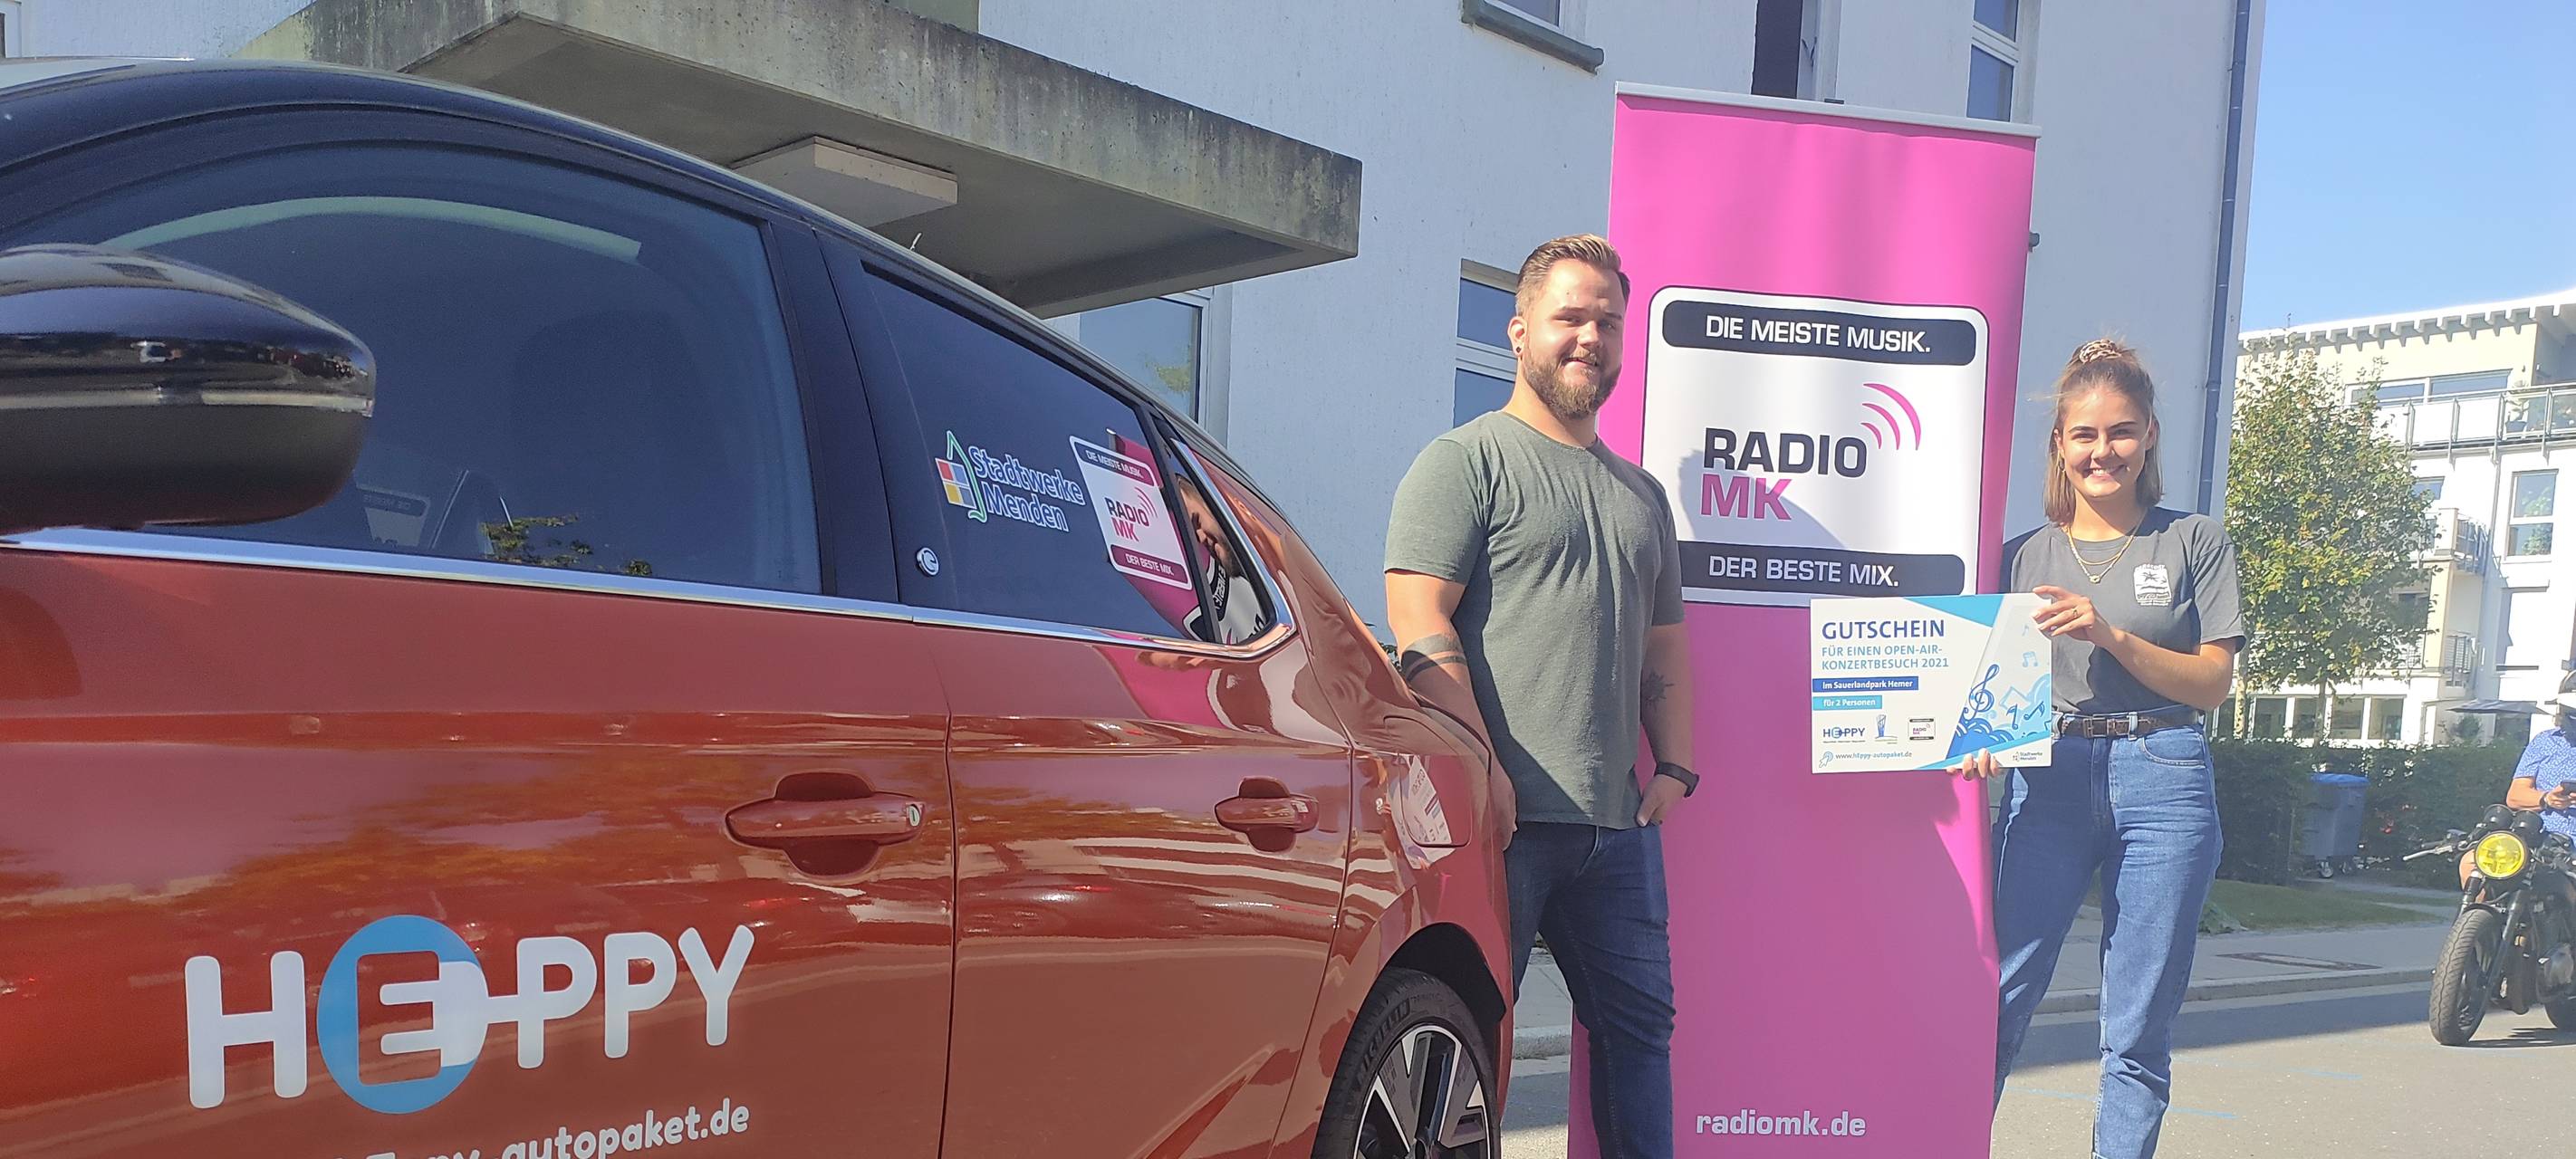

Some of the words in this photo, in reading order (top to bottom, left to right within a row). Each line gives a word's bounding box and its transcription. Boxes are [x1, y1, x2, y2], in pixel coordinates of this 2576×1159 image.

[1706, 314, 1744, 340] DIE
[1751, 319, 1841, 346] MEISTE
[1847, 326, 1931, 353] MUSIK.
[1703, 427, 1868, 478] RADIO
[968, 445, 1086, 506] Stadtwerke
[981, 481, 1070, 532] Menden
[1700, 473, 1793, 521] MK
[1104, 497, 1150, 527] RADIO
[1111, 517, 1139, 542] MK
[1125, 553, 1140, 566] DER
[1139, 557, 1160, 572] BESTE
[1708, 555, 1757, 579] DER
[1766, 559, 1841, 582] BESTE
[1849, 563, 1899, 587] MIX.
[1821, 619, 1945, 640] GUTSCHEIN
[1821, 644, 1844, 657] FÜR
[1847, 646, 1881, 656] EINEN
[1884, 644, 1943, 656] OPEN-AIR-
[1821, 658, 1918, 670] KONZERTBESUCH
[1921, 657, 1948, 668] 2021
[1833, 679, 1888, 691] Sauerlandpark
[1888, 679, 1914, 688] Hemer
[1823, 698, 1836, 707] für
[1836, 699, 1841, 707] 2
[1841, 698, 1876, 707] Personen
[1696, 1108, 1867, 1137] radiomk.de
